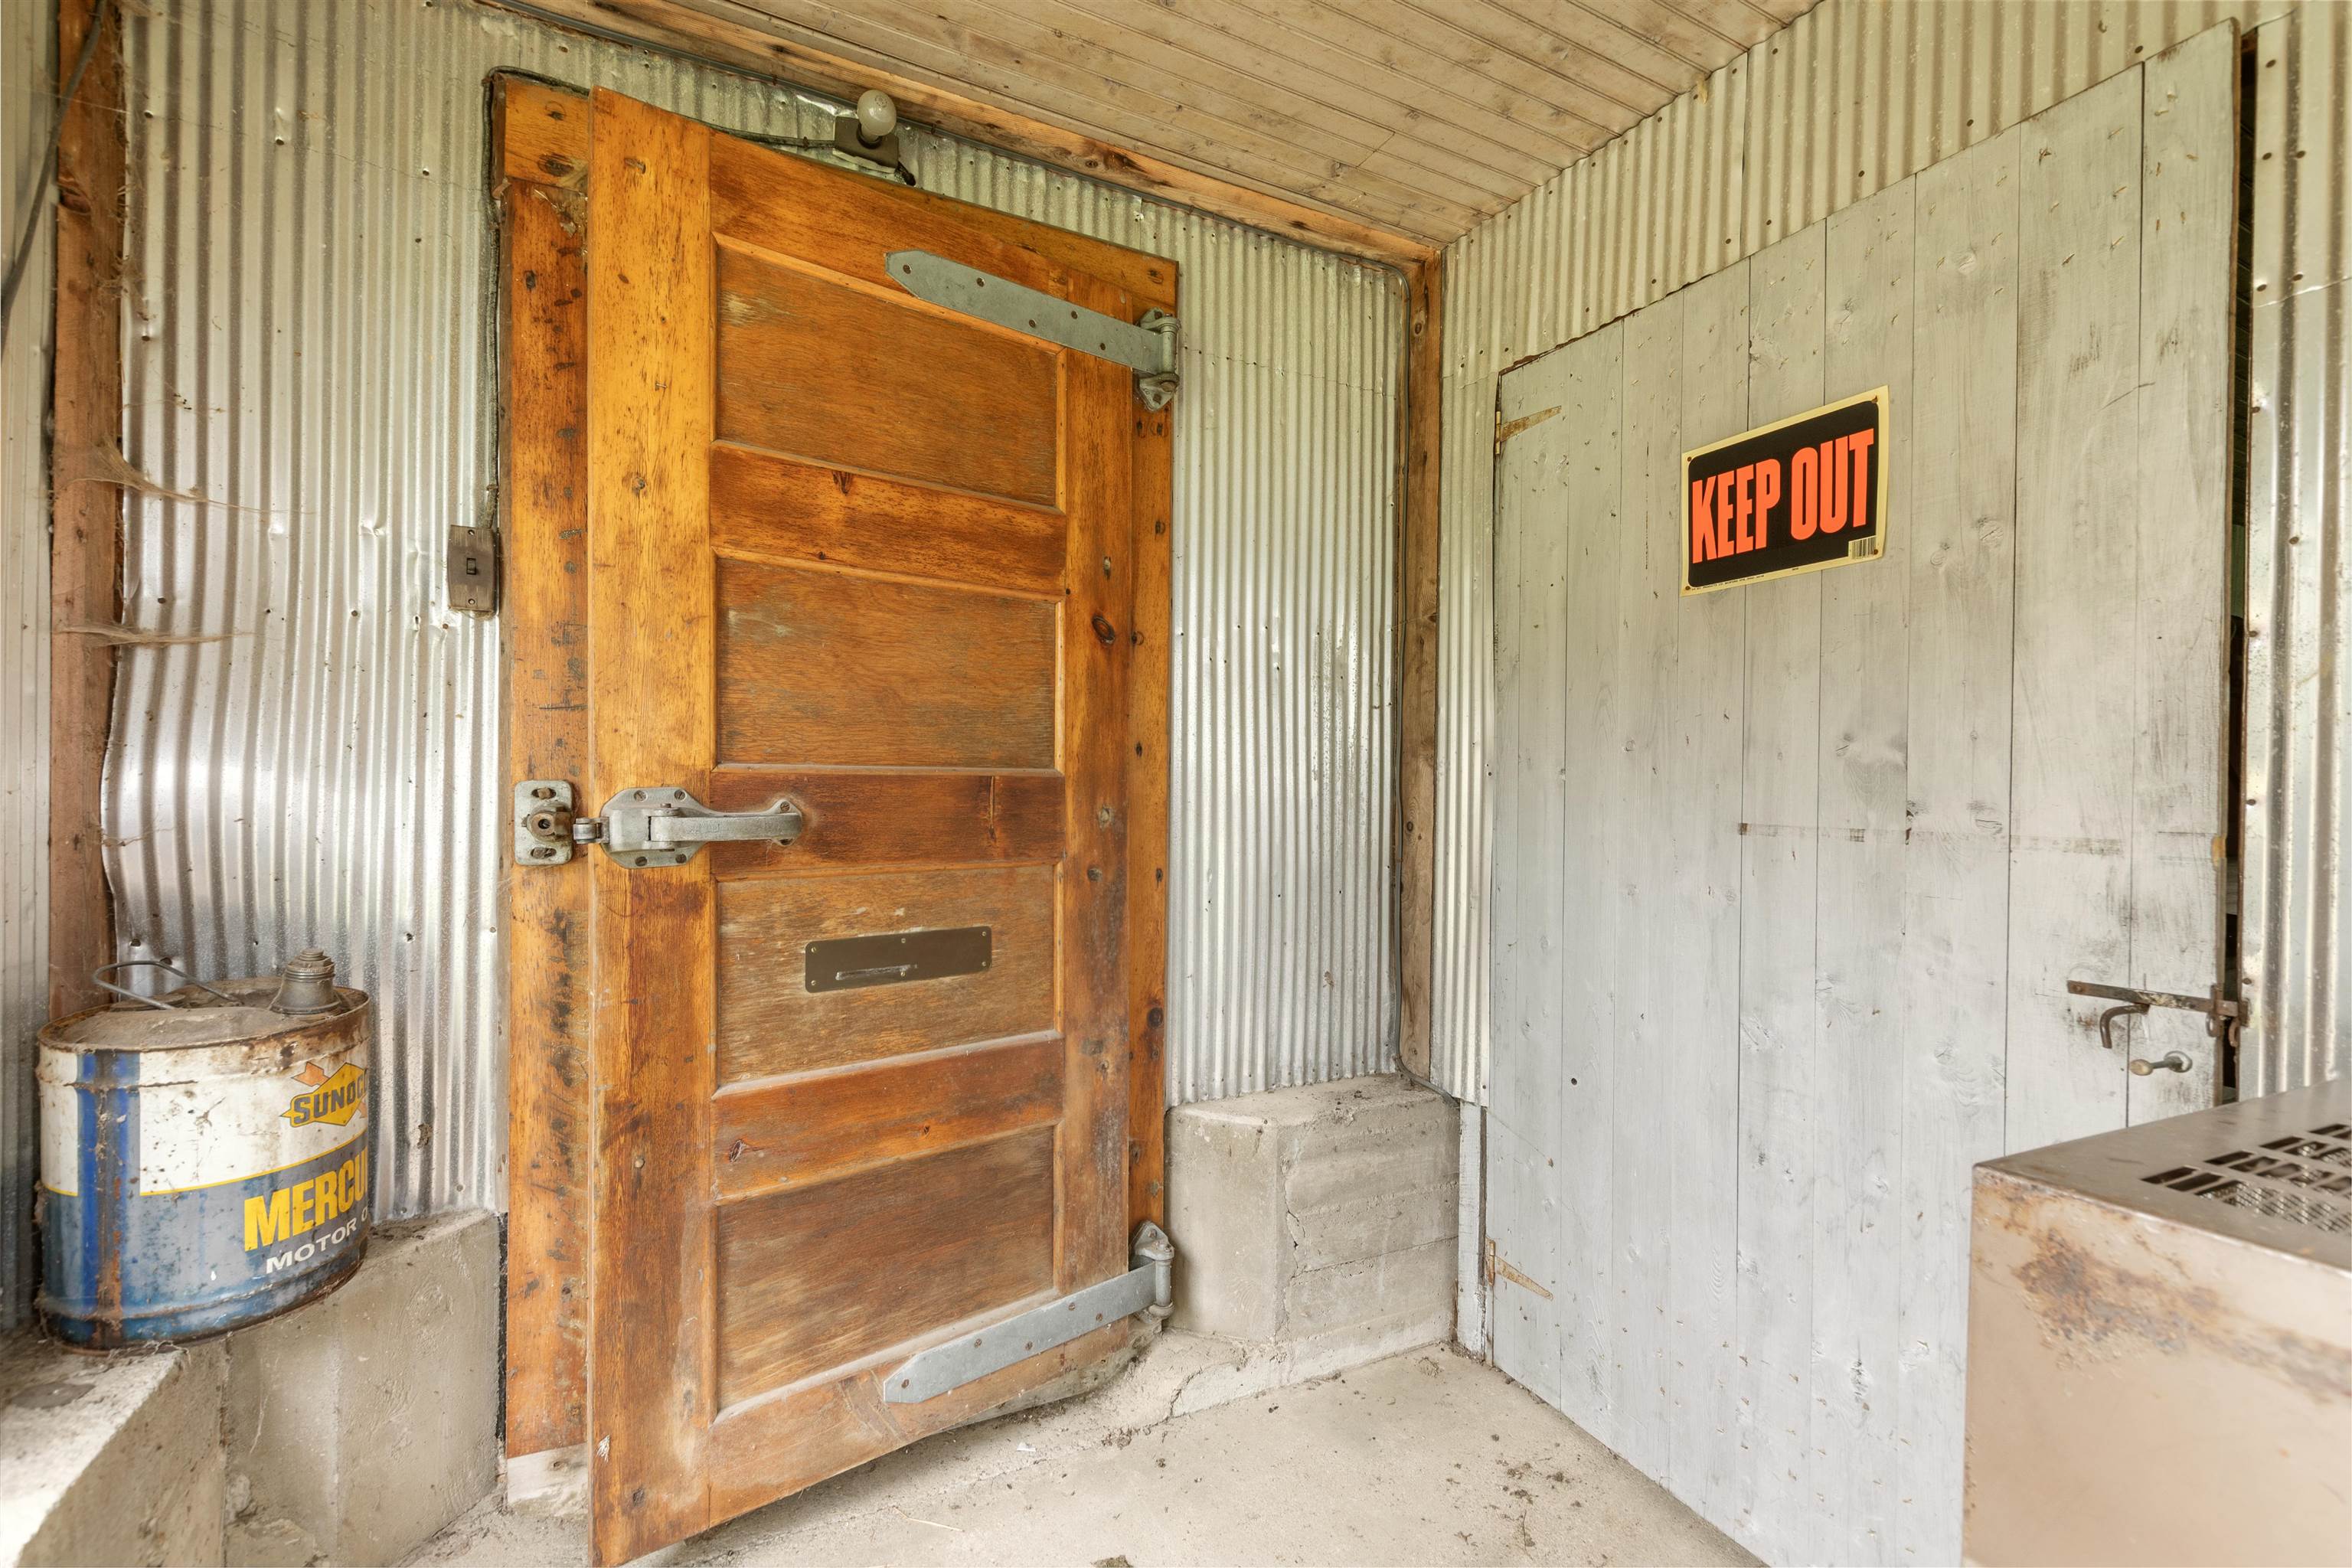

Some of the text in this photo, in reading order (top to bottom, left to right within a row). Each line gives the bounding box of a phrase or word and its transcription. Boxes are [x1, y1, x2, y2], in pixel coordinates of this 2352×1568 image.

[1692, 428, 1874, 564] KEEP OUT
[293, 1068, 367, 1124] SUNOC
[244, 1146, 368, 1252] MERCU
[266, 1217, 357, 1274] MOTOR
